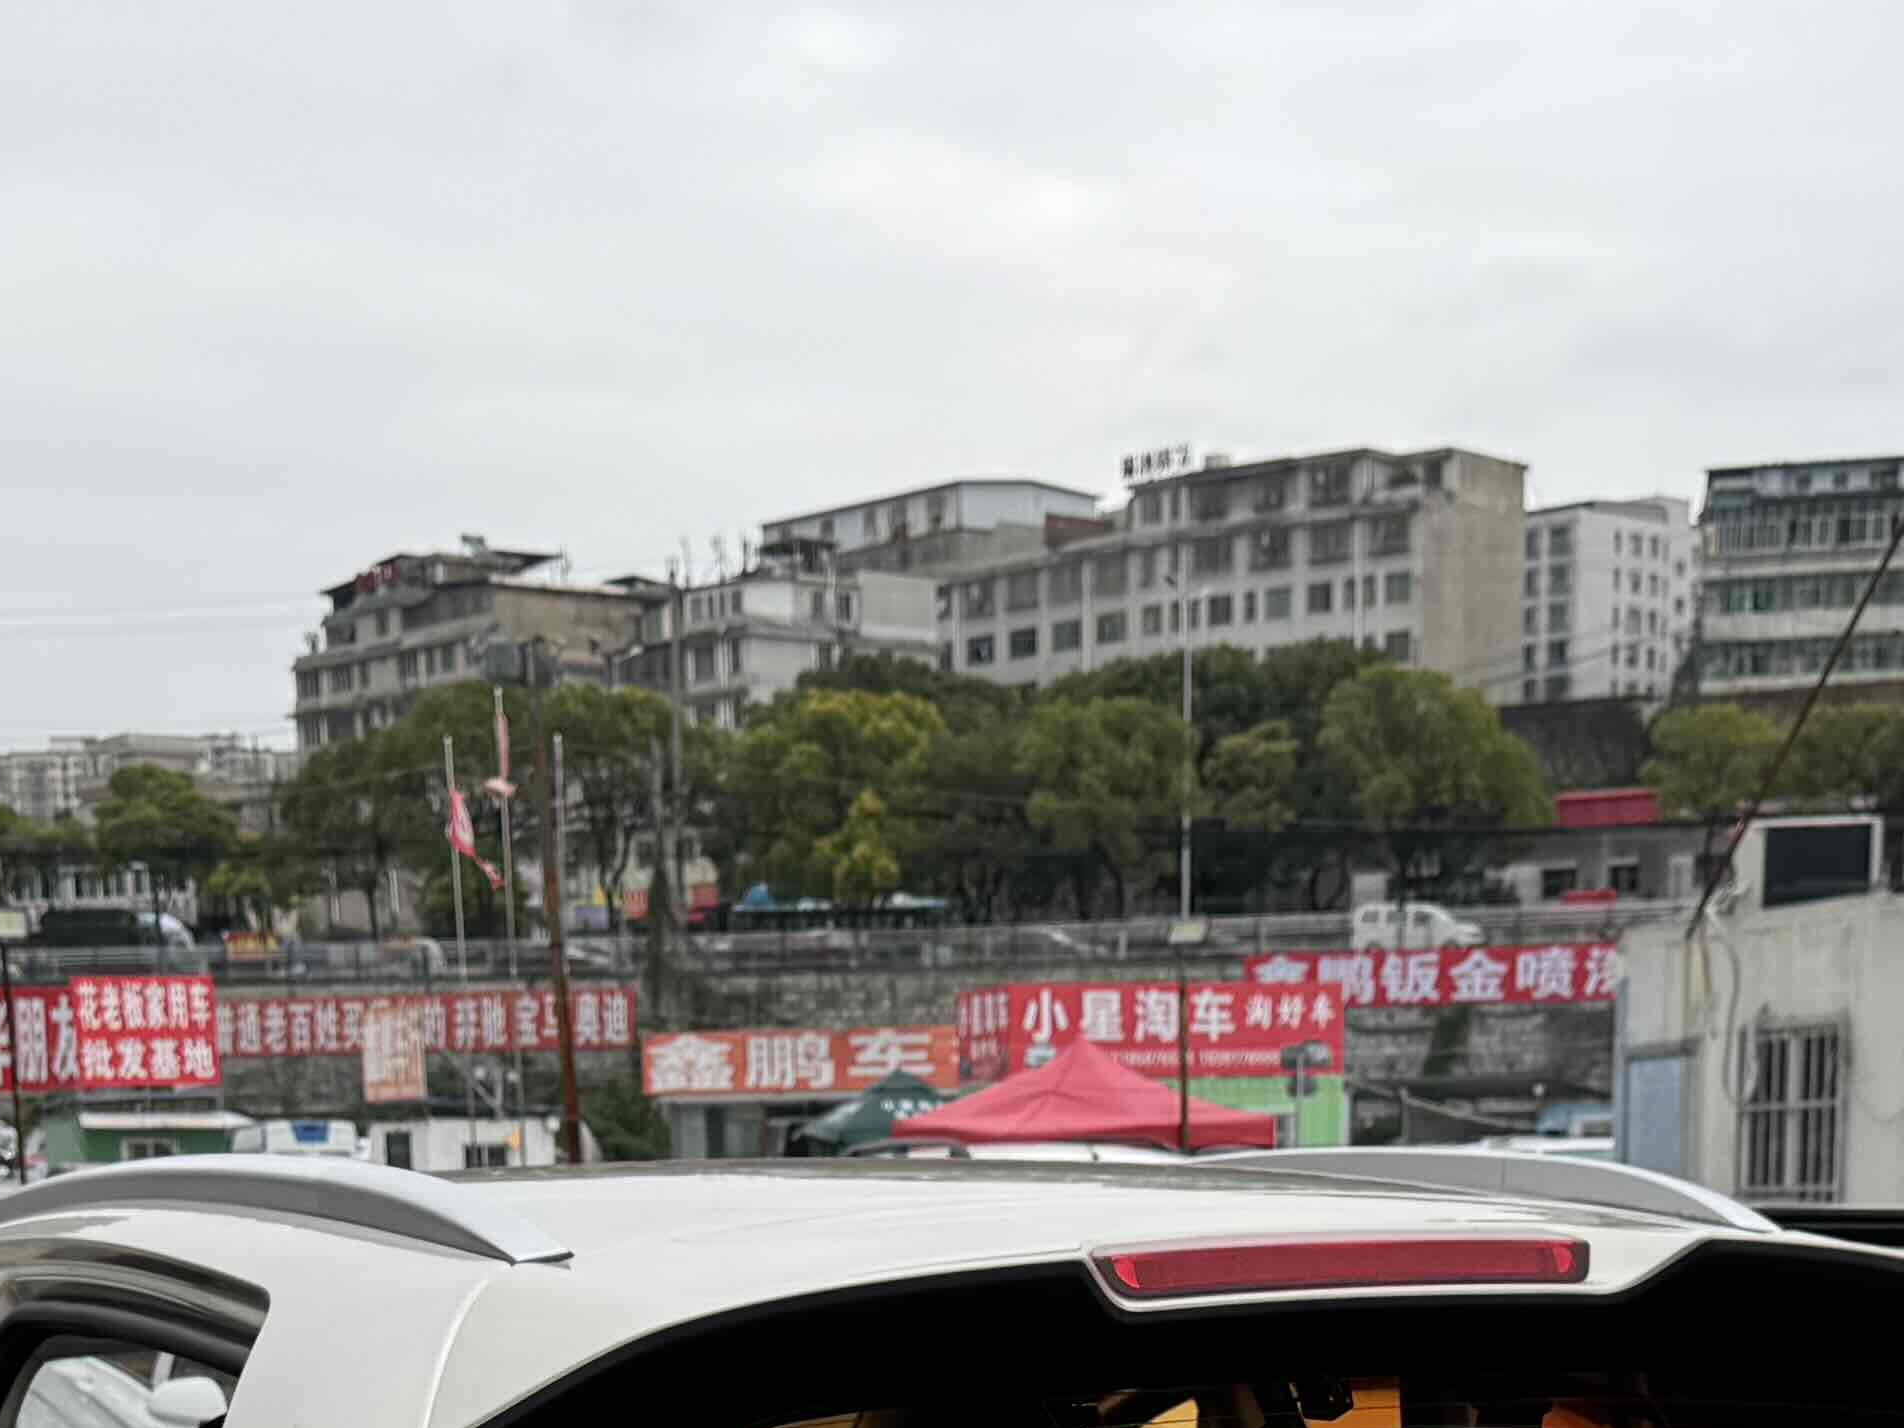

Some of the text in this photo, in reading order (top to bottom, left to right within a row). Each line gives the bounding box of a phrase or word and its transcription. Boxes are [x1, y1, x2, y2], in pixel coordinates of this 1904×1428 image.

[216, 991, 628, 1054] 普通老百姓买的奔驰宝马奥迪
[1023, 988, 1236, 1042] 小星淘车
